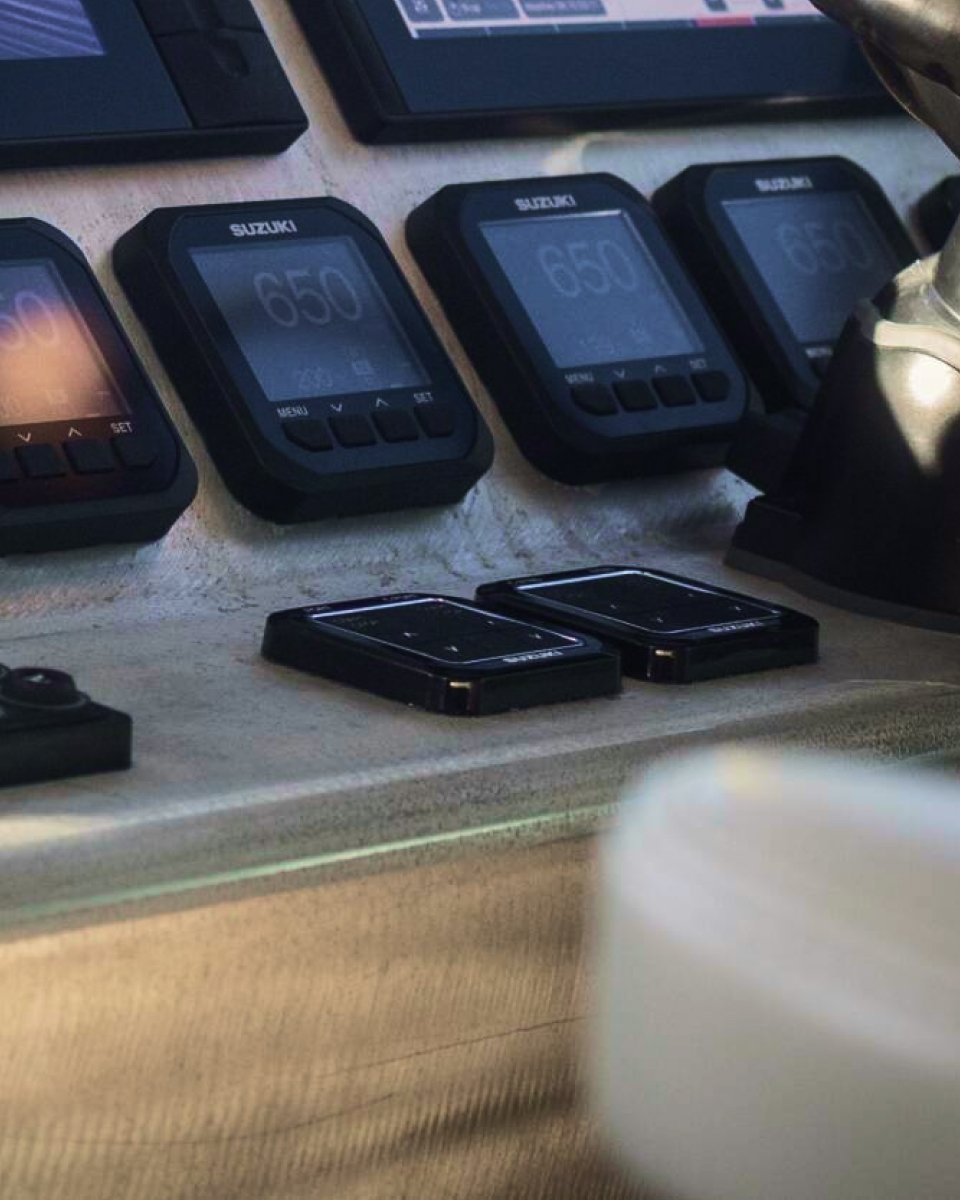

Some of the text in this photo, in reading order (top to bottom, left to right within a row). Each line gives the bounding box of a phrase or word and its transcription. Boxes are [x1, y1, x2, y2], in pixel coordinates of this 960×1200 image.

[514, 195, 577, 211] SUZUKI
[230, 220, 297, 236] SUZUKI
[541, 240, 637, 297] 650
[253, 266, 362, 327] 650
[277, 406, 309, 418] MENU
[110, 421, 133, 434] SET
